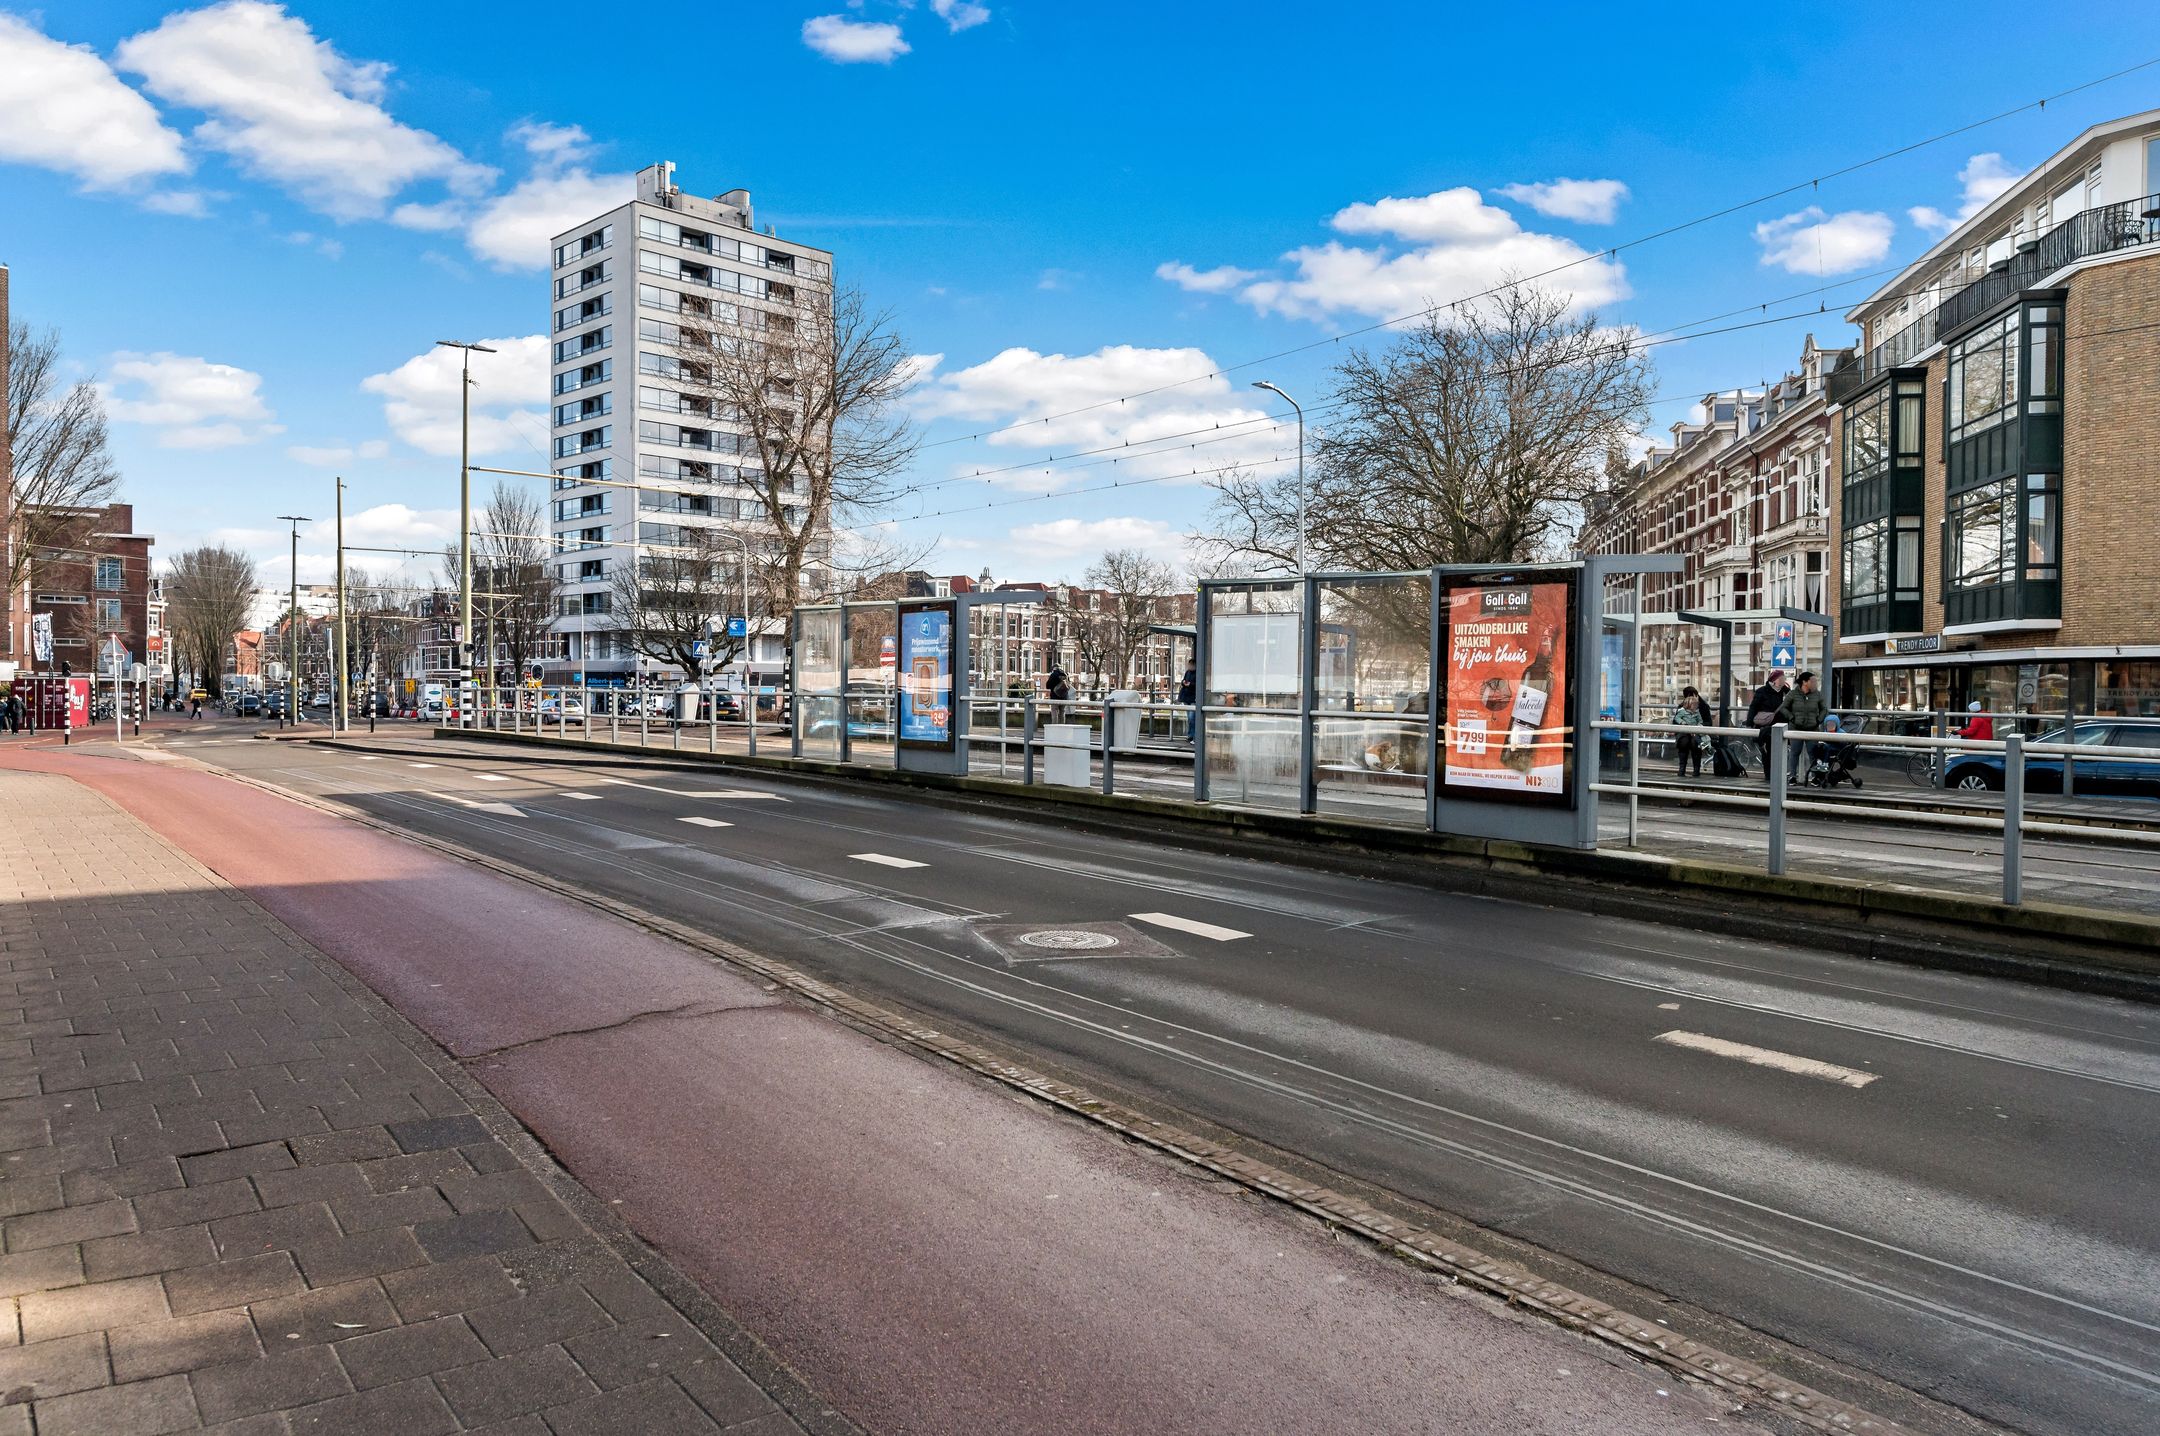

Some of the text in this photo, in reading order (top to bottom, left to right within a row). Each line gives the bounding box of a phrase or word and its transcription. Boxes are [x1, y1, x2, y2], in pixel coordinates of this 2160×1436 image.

[1485, 592, 1528, 606] Gall Gall
[1454, 622, 1528, 635] UITZONDERLIJKE
[1454, 636, 1490, 648] SMAKEN
[1897, 637, 1937, 651] TRENDY FLOOR
[1467, 648, 1492, 669] jou
[1495, 643, 1528, 663] thuis
